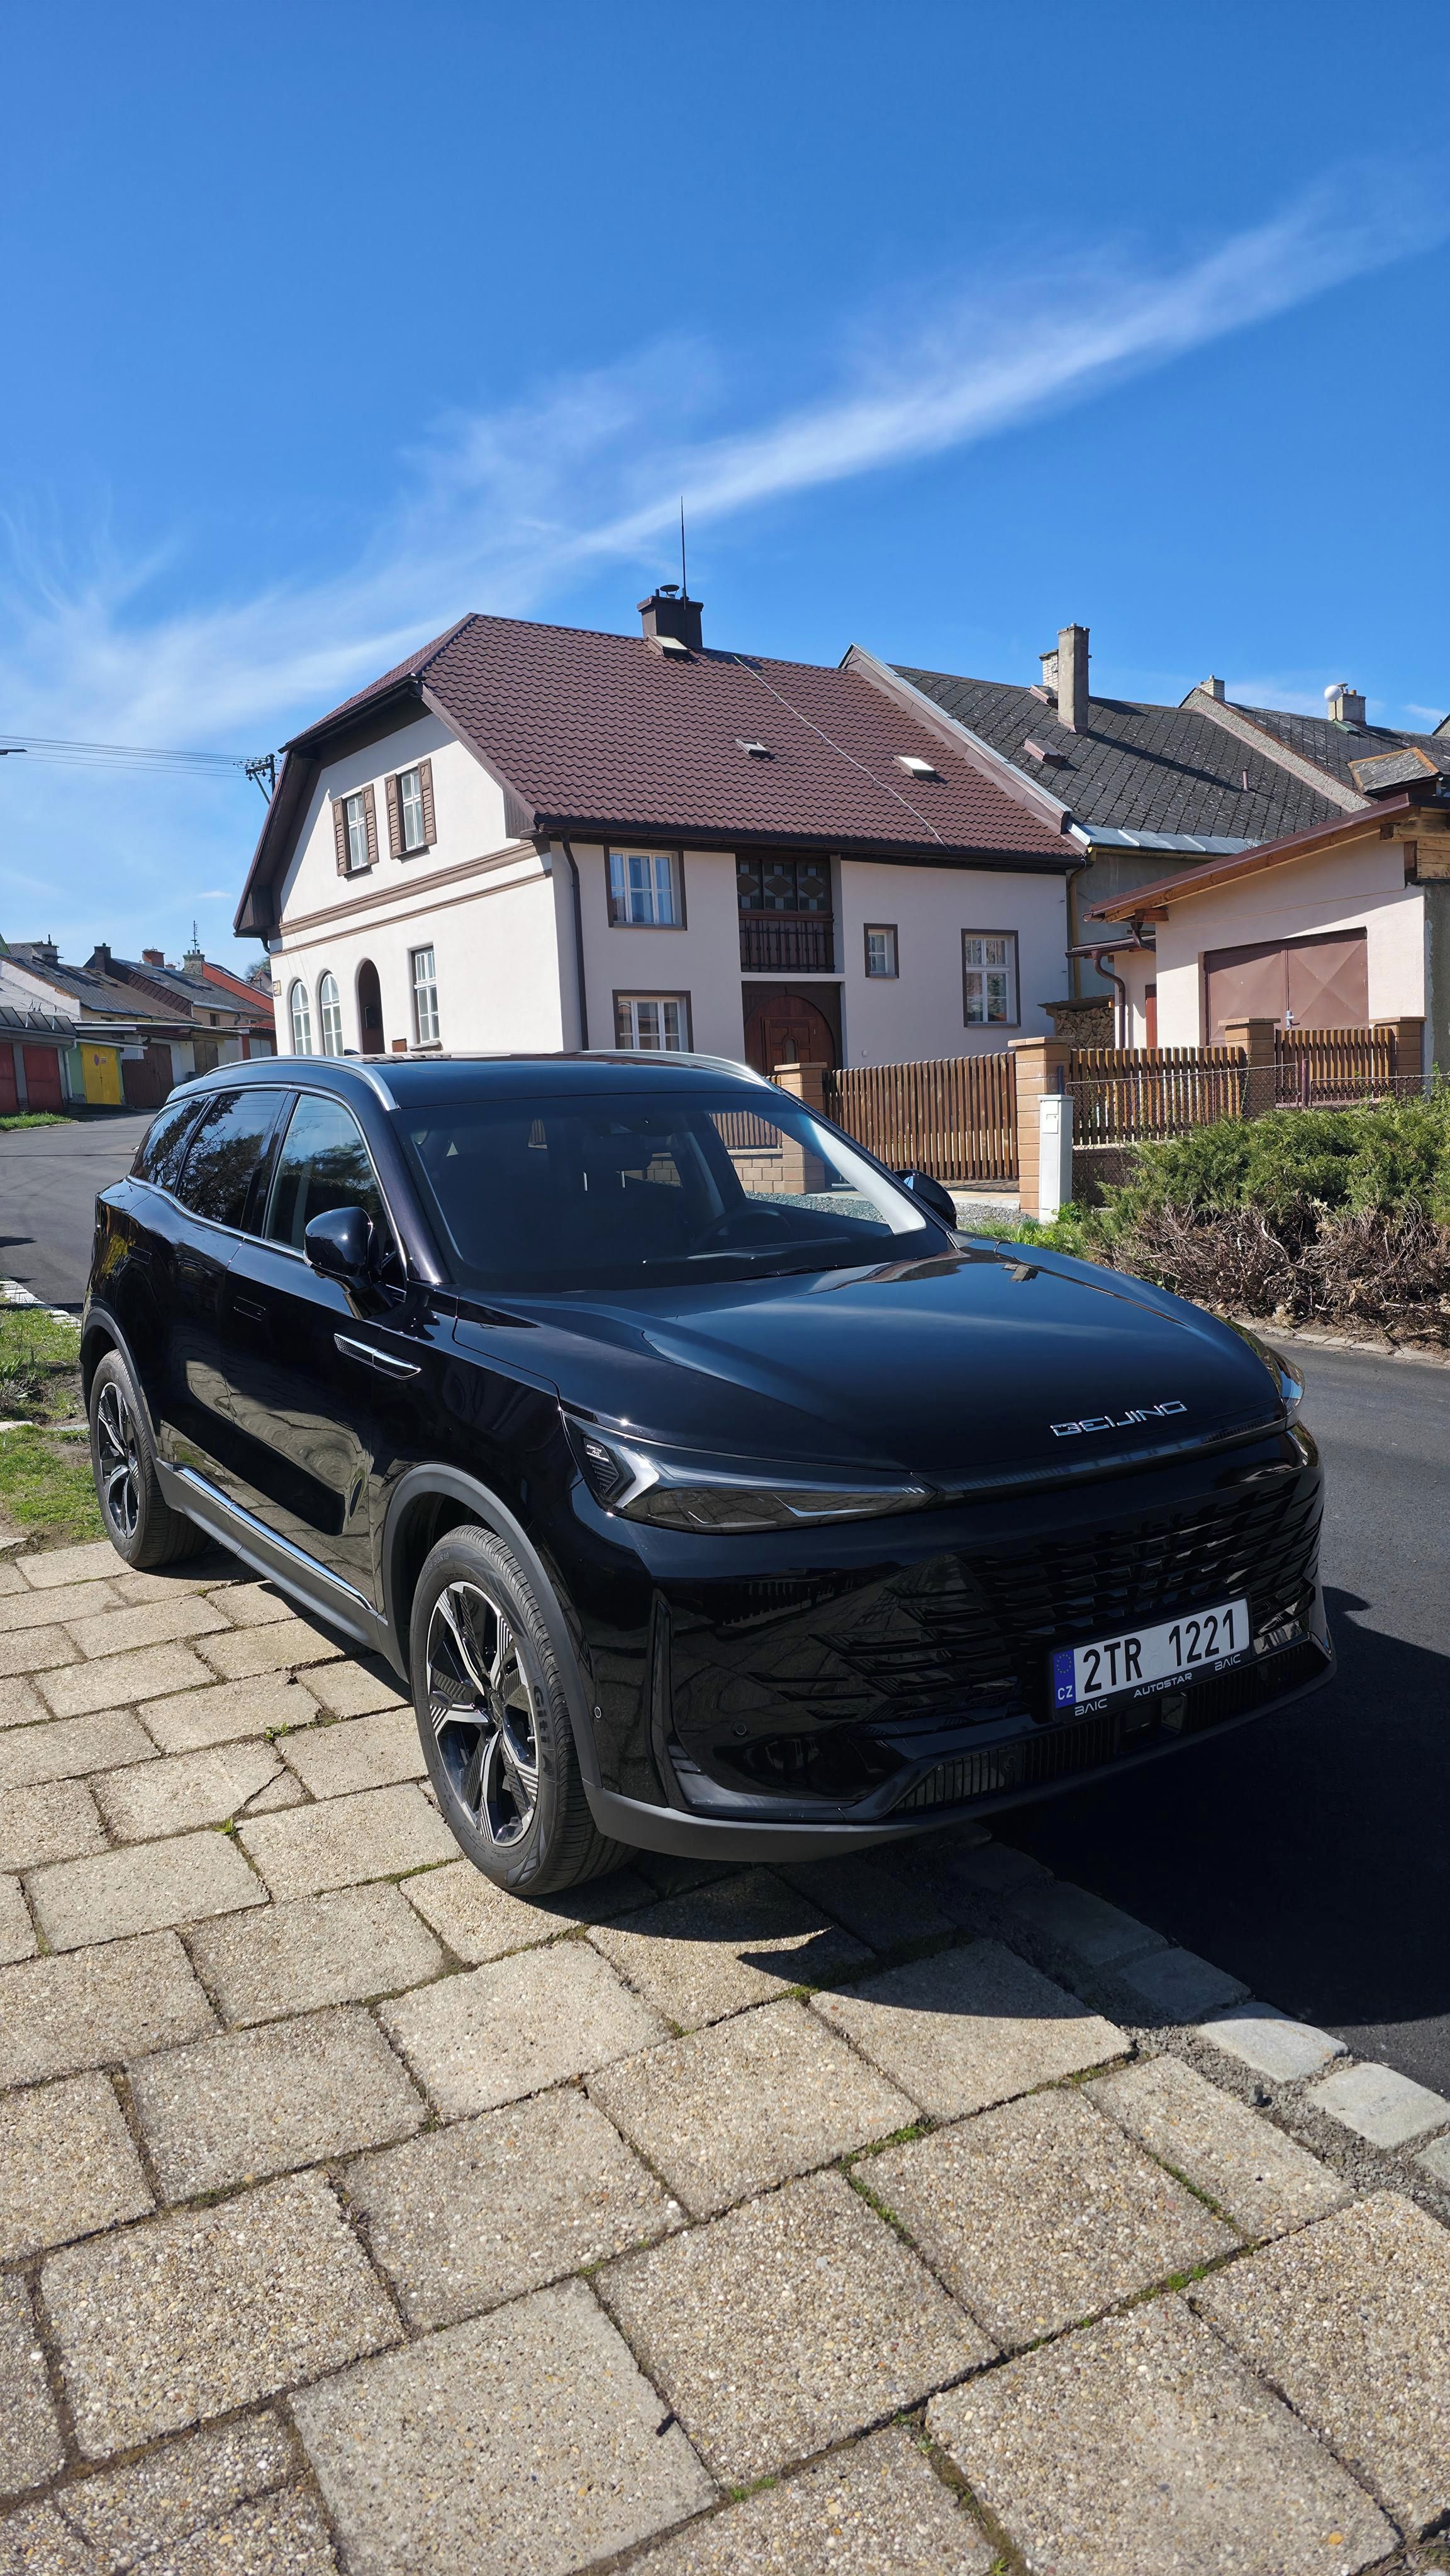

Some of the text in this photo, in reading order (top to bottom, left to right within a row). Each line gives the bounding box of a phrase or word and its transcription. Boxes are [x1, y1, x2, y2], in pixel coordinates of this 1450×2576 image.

[1050, 1401, 1188, 1436] BEIJING
[1083, 1609, 1234, 1694] 2TR 1221
[1057, 1685, 1073, 1701] CZ
[1074, 1653, 1241, 1716] BAIC AUTOSTAR BAIC
[533, 1685, 551, 1743] Giti
